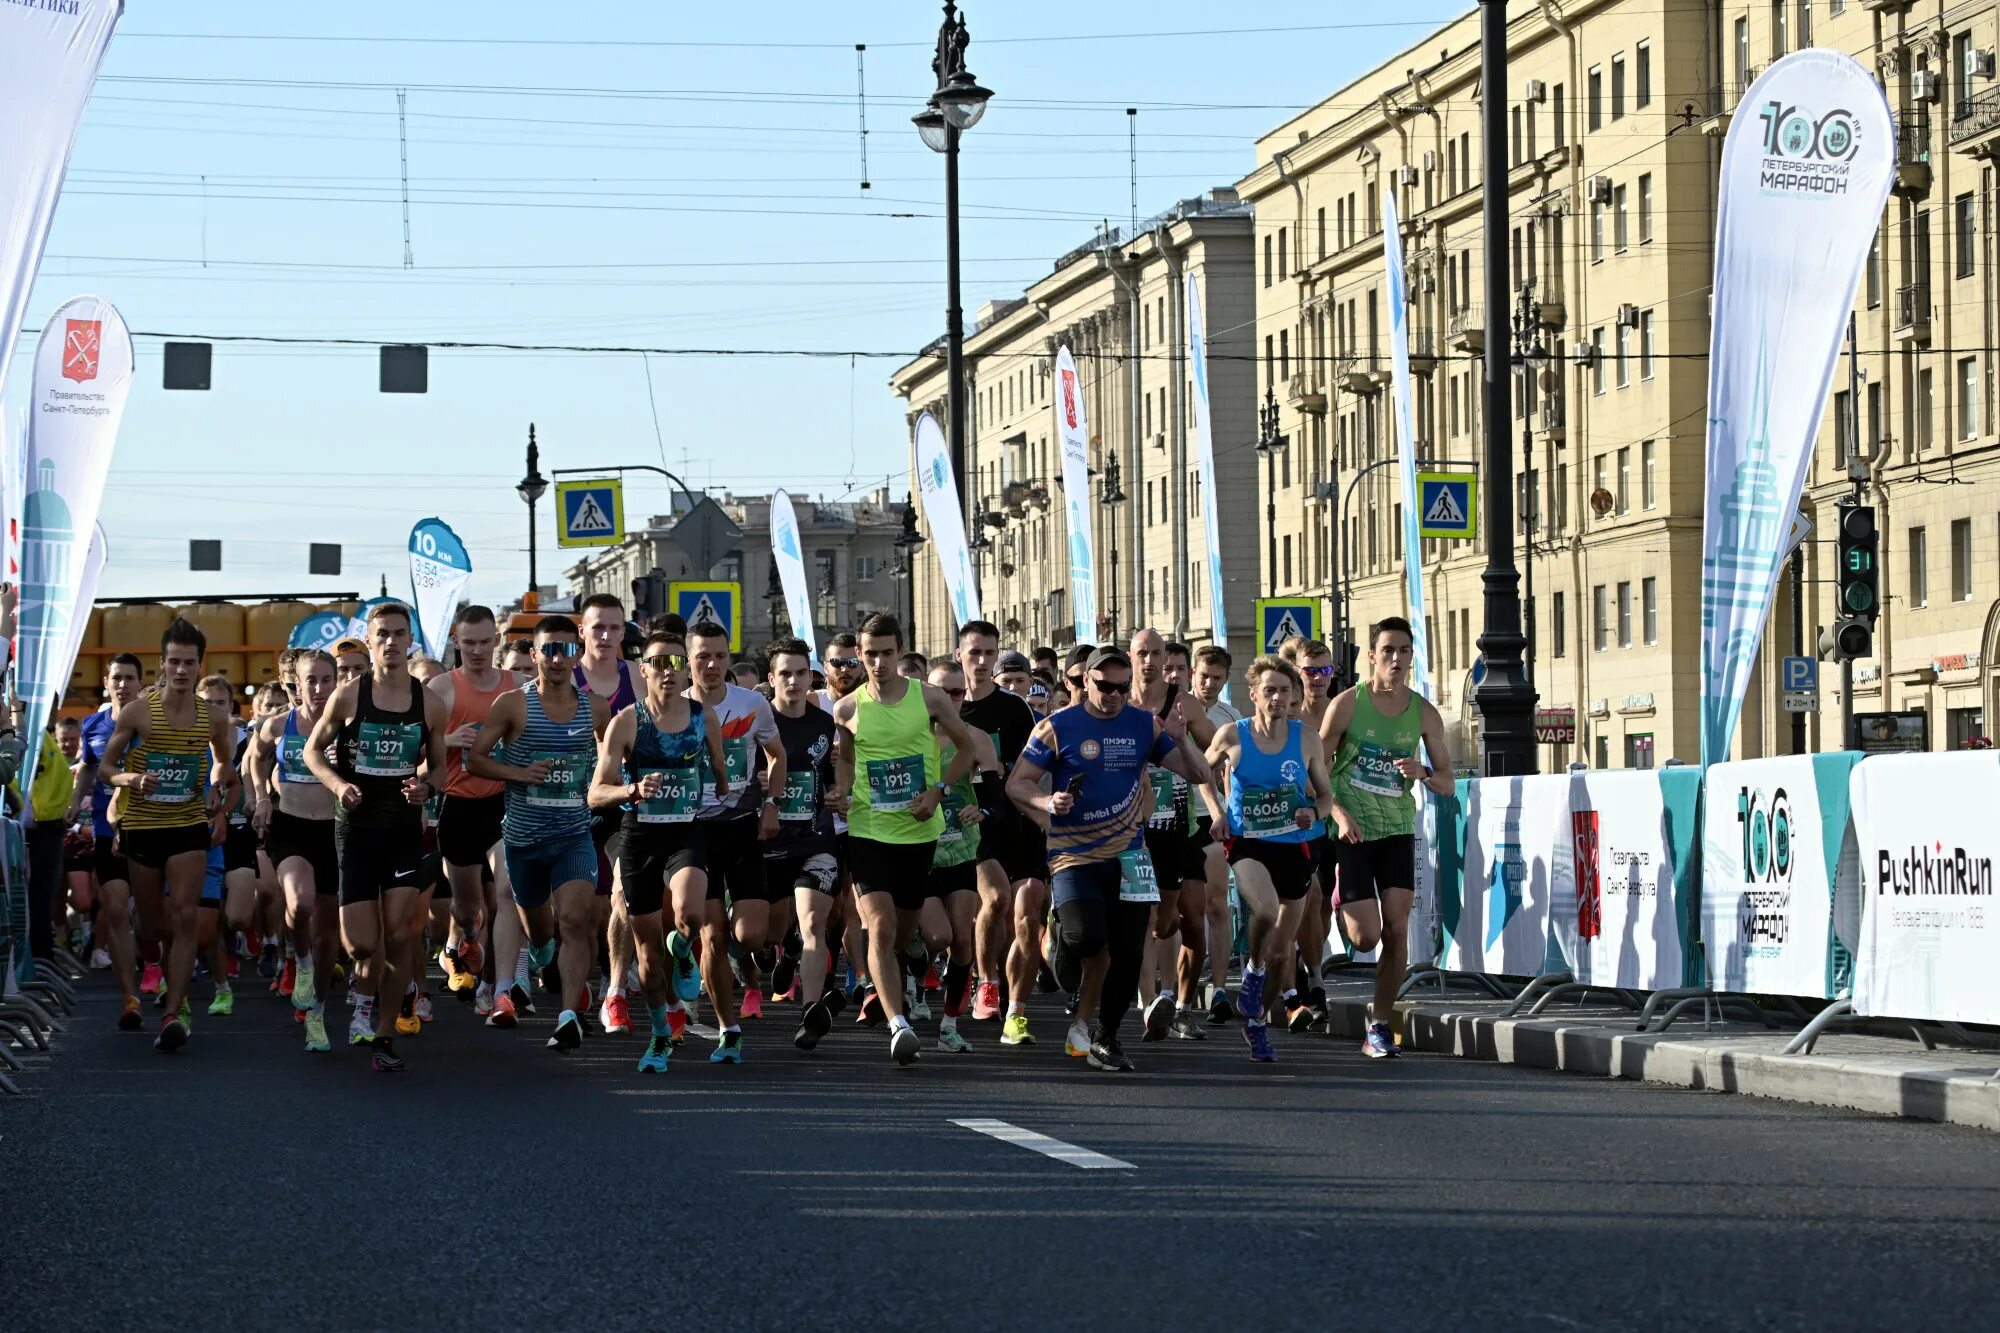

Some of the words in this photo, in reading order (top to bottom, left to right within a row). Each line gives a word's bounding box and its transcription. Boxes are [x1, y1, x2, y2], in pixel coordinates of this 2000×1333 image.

[0, 0, 79, 15] ЕТИКИ
[1762, 159, 1850, 175] ПЕТЕРБУРГСКИЙ
[1760, 171, 1848, 194] МАРАФОН
[49, 389, 106, 401] Правительство
[42, 403, 111, 417] Санкт-Петербурга
[414, 530, 436, 556] 10
[1850, 551, 1870, 570] 31
[1103, 737, 1136, 746] ПМЭФ'23
[1536, 728, 1574, 742] VAPE
[374, 740, 403, 754] 1371
[1366, 758, 1398, 775] 2304
[158, 768, 190, 781] 2927
[883, 772, 912, 788] 1913
[1252, 801, 1289, 816] 6068
[1878, 840, 1992, 896] PushkinRun
